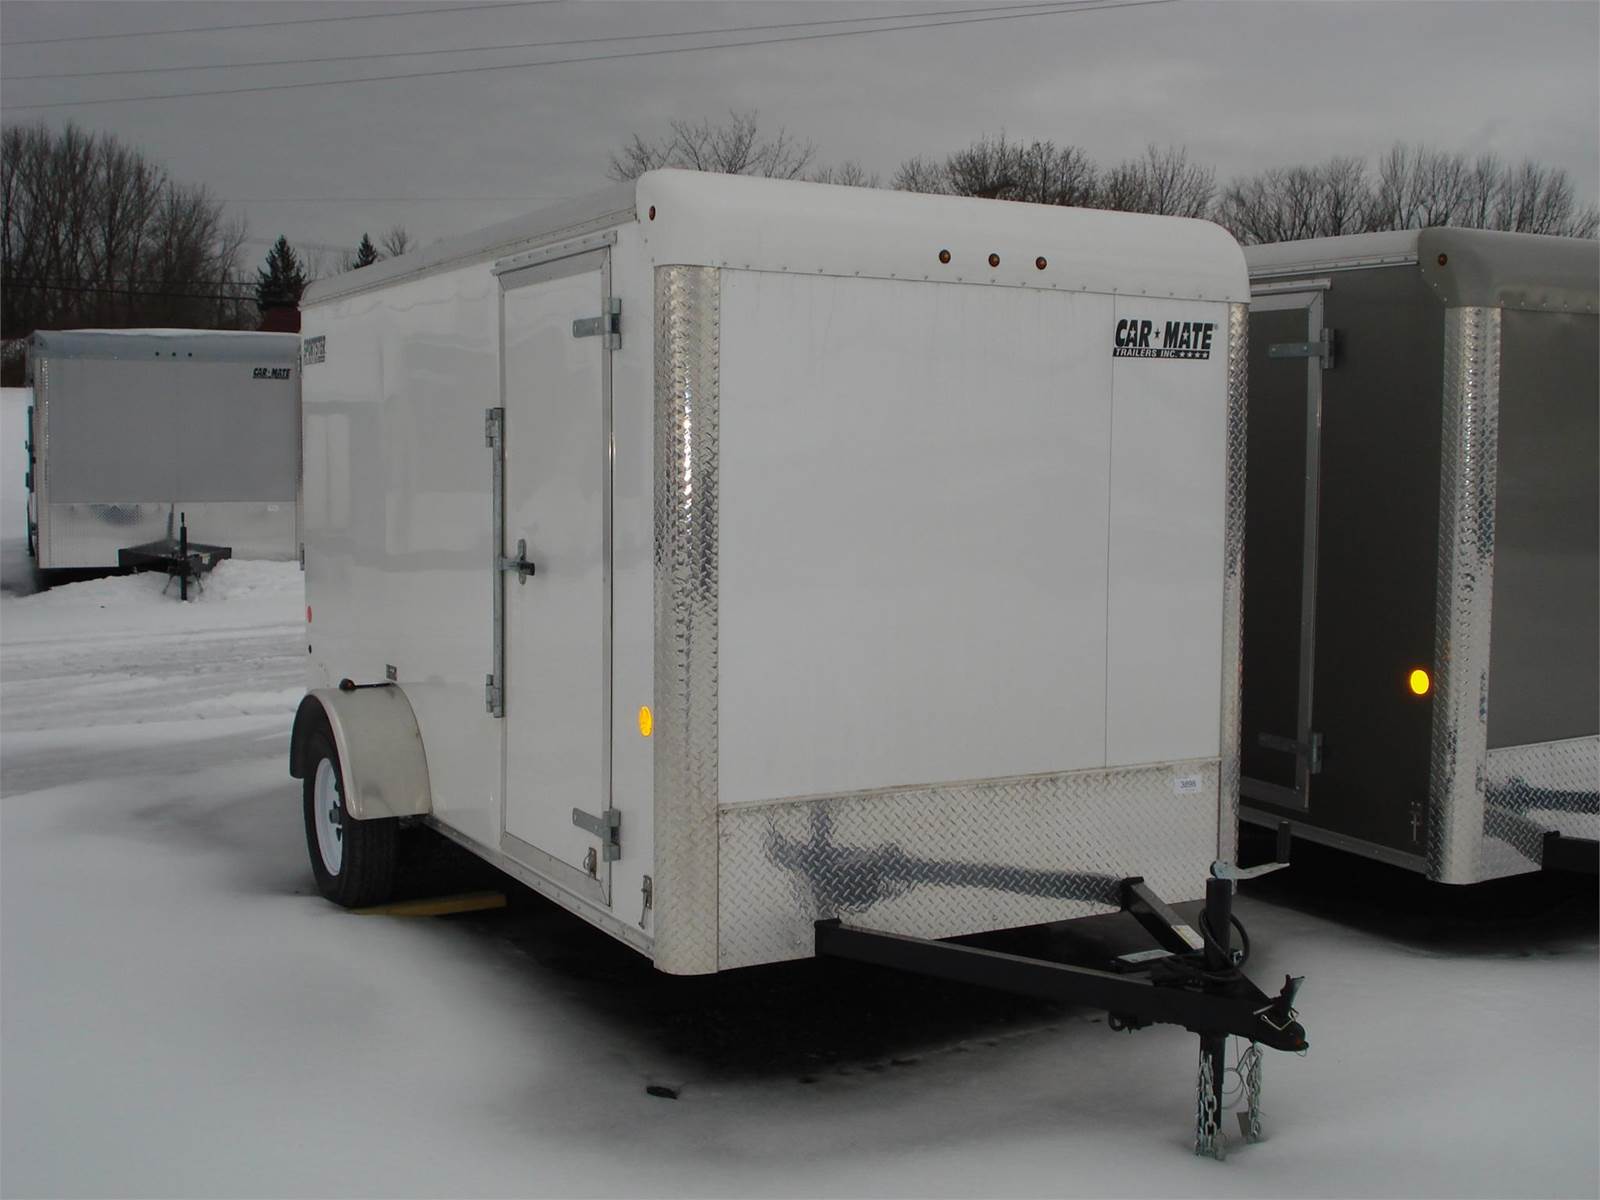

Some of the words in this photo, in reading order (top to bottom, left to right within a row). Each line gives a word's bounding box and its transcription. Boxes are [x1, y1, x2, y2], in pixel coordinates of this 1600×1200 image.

[1115, 319, 1152, 347] CAR
[1163, 321, 1213, 350] MATE
[1115, 348, 1157, 358] TRAILERS
[253, 367, 268, 377] CAR
[271, 367, 290, 377] MATE
